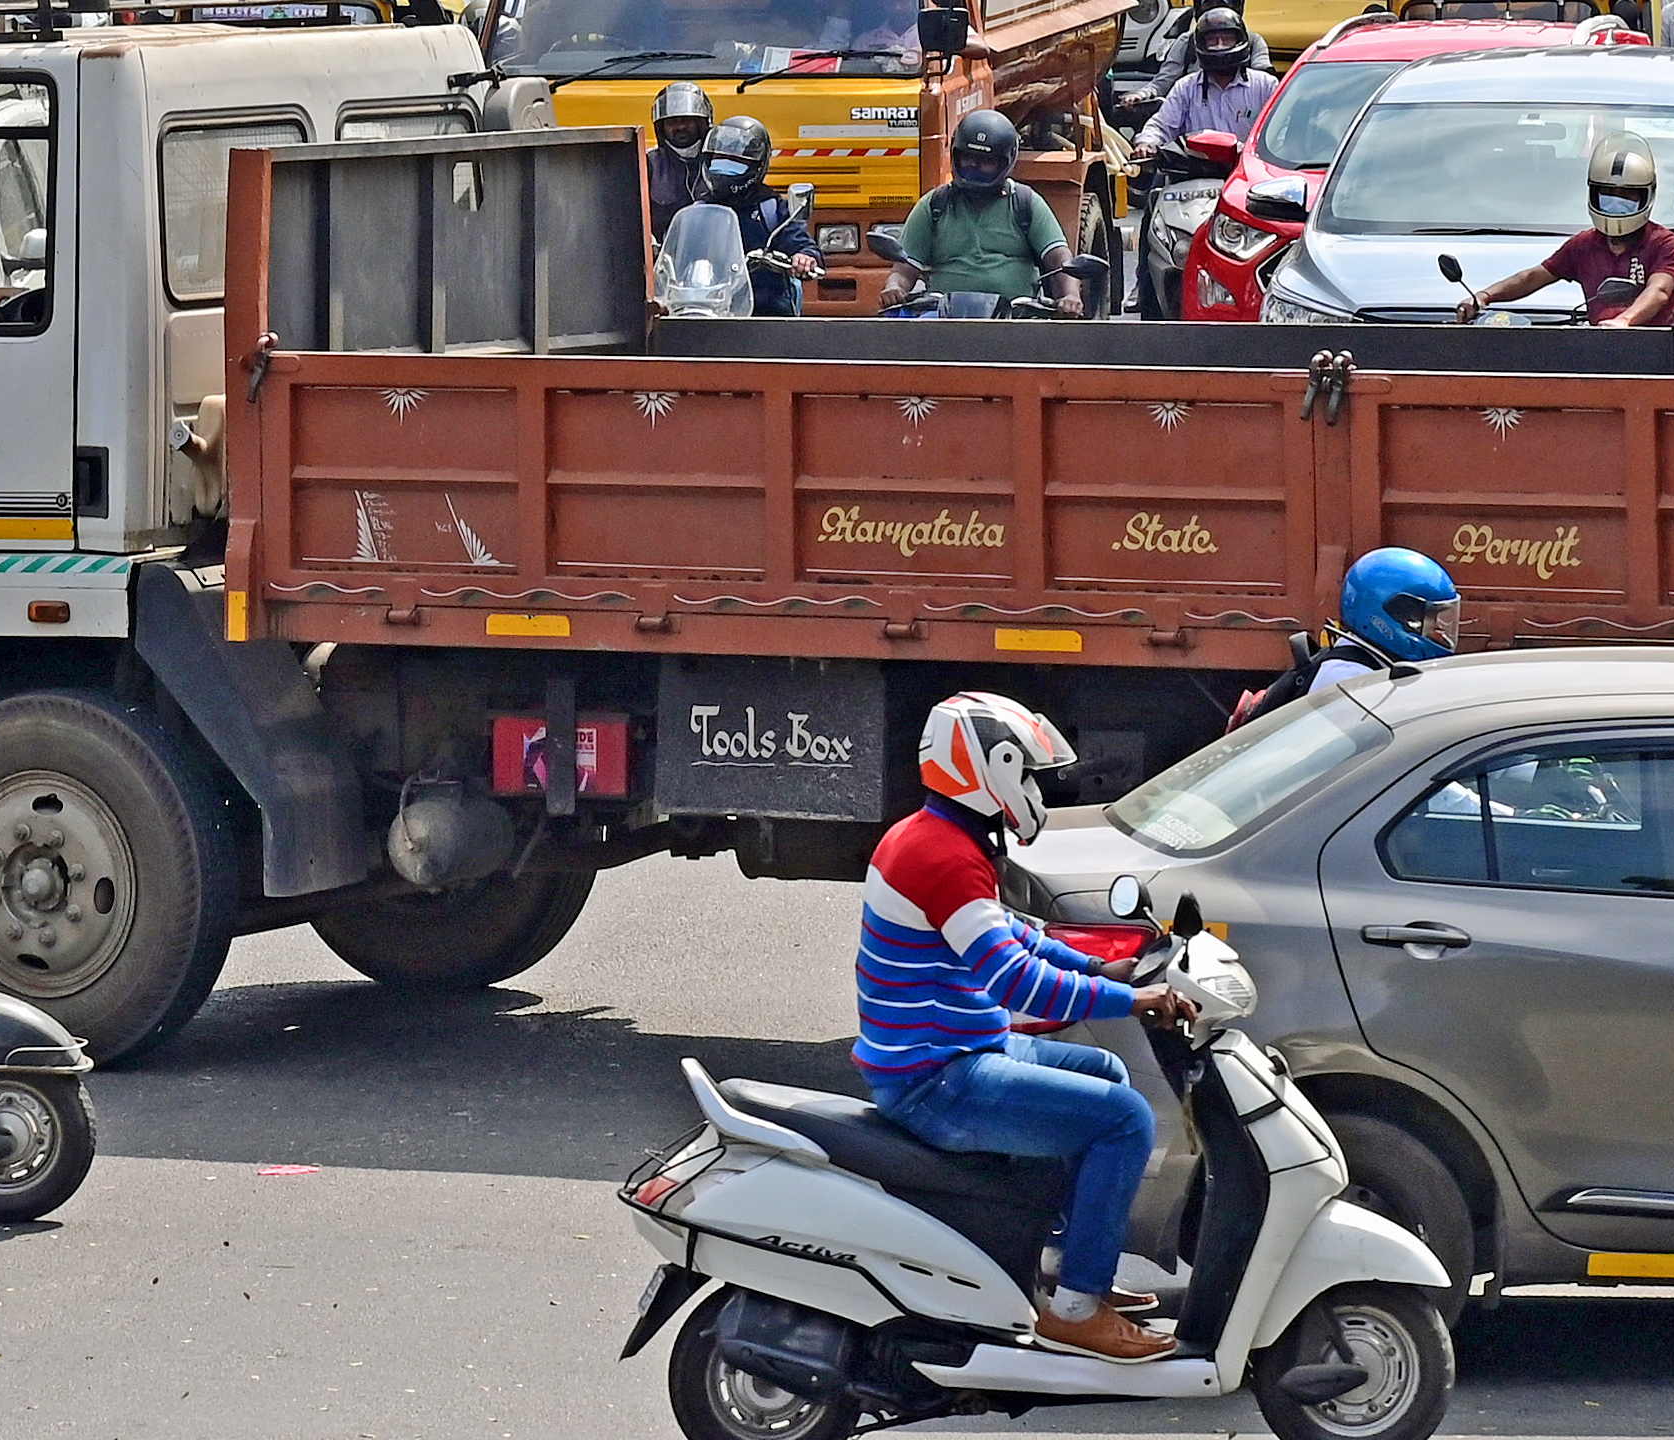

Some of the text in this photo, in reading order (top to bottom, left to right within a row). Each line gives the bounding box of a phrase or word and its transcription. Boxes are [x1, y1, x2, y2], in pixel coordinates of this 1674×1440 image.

[817, 506, 1006, 558] Karnataka
[690, 704, 853, 761] Tools Box
[755, 1234, 858, 1262] Activa
